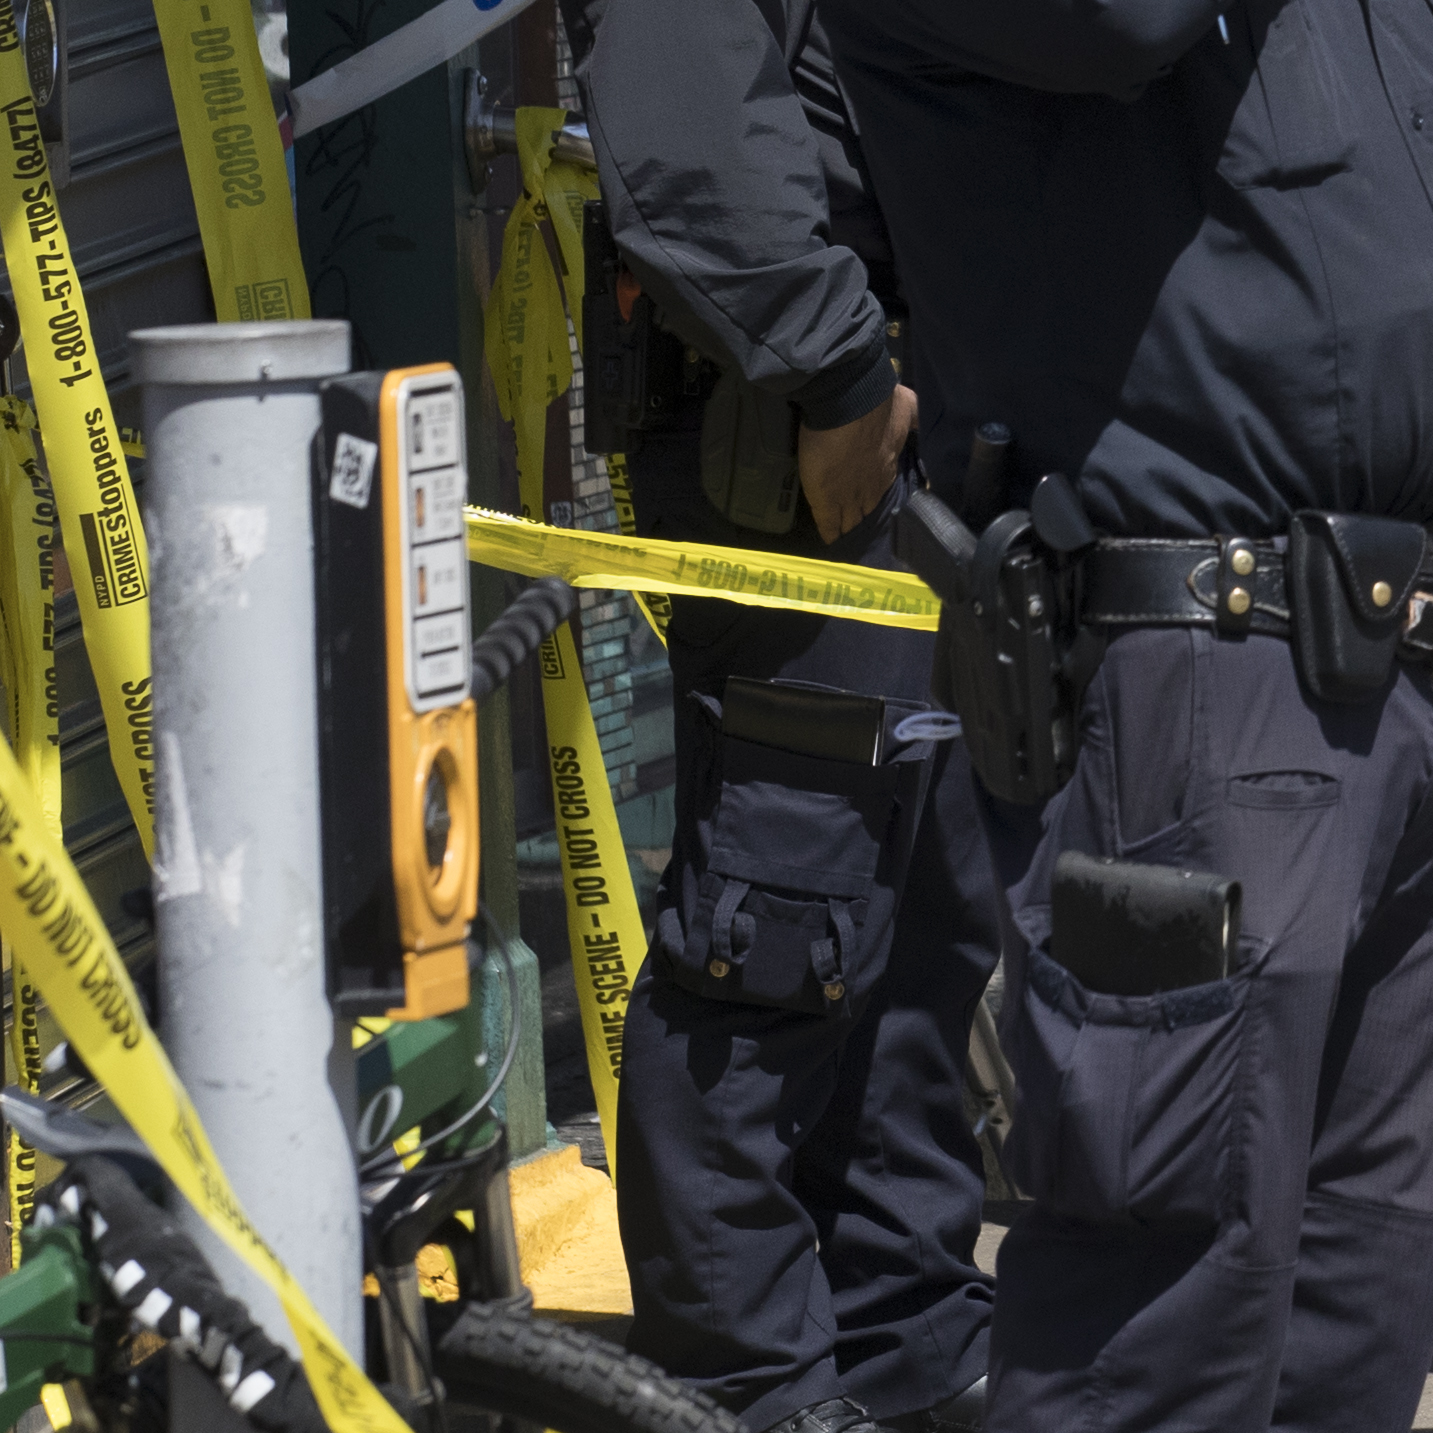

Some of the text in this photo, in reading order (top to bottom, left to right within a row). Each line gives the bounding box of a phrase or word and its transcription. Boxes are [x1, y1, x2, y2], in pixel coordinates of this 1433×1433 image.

[22, 180, 92, 388] 1-800-577-TIPS
[84, 406, 147, 600] CRIMEstoppers
[551, 744, 590, 821] CROSS
[563, 827, 602, 870] NOT
[573, 875, 610, 907] DO
[584, 931, 632, 1005] SCENE
